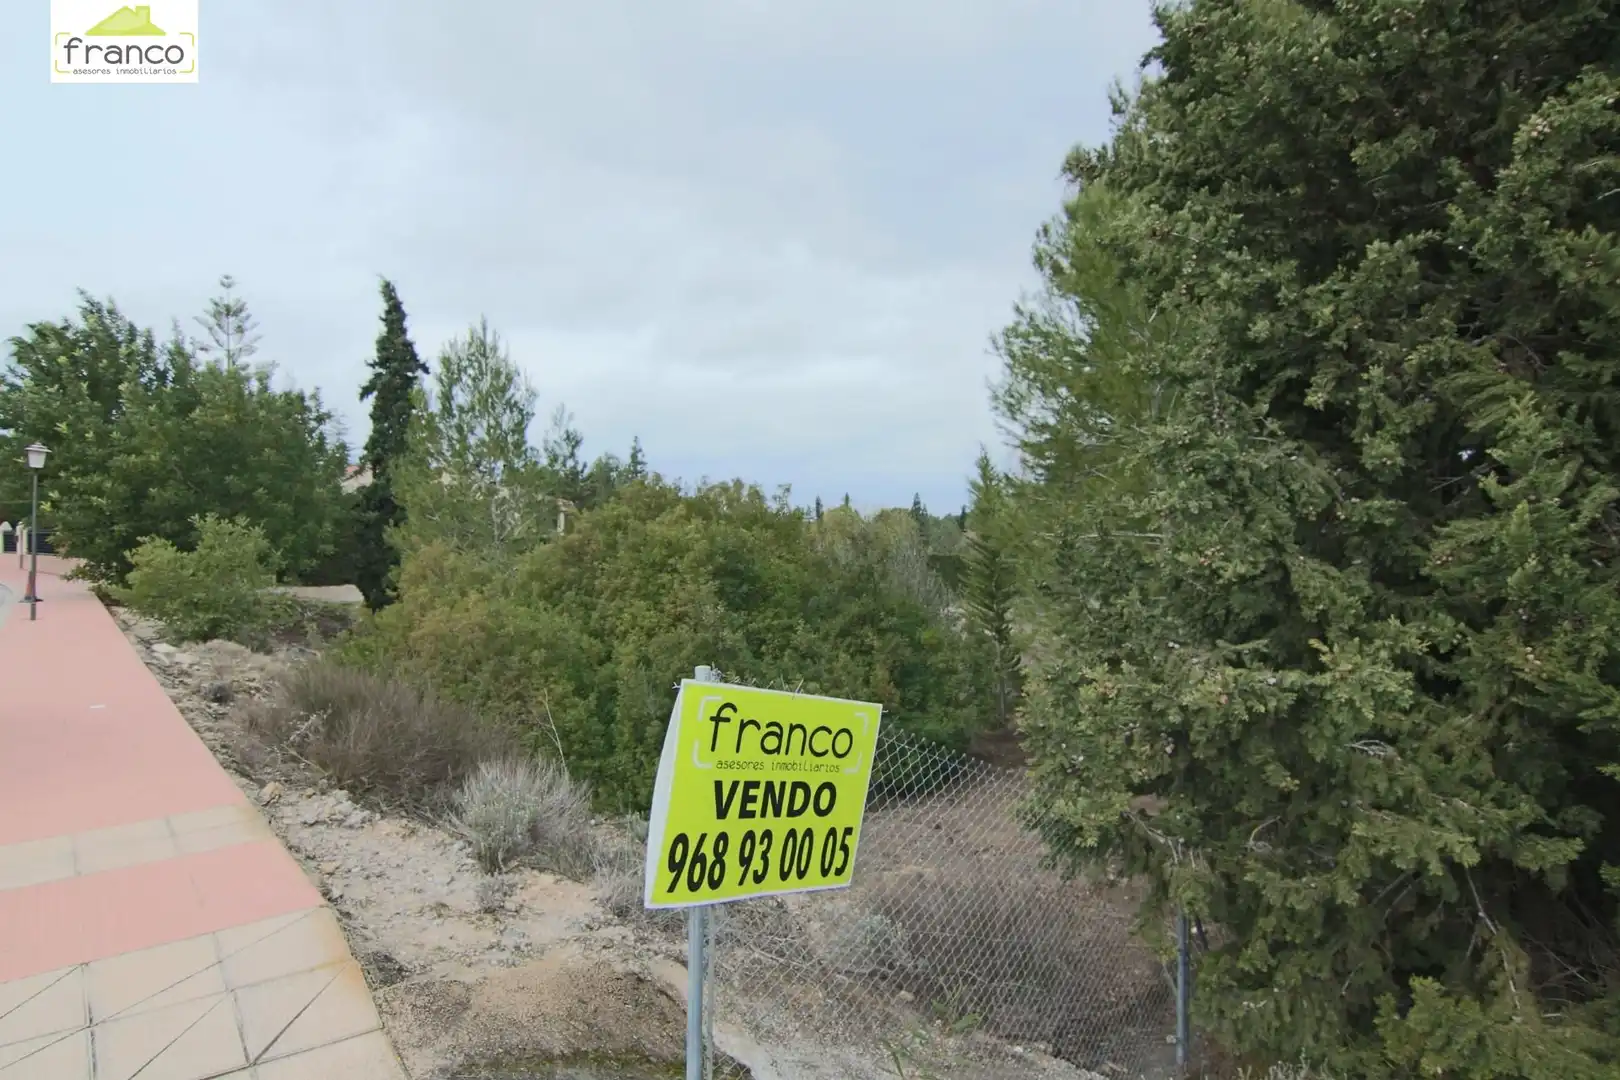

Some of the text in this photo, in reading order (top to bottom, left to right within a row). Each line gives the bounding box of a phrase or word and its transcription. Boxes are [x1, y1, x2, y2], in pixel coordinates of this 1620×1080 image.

[709, 702, 853, 759] franco
[716, 759, 840, 773] asesores inmobiliarios
[714, 780, 837, 820] VENDO
[666, 826, 853, 893] 968 93 00 05
